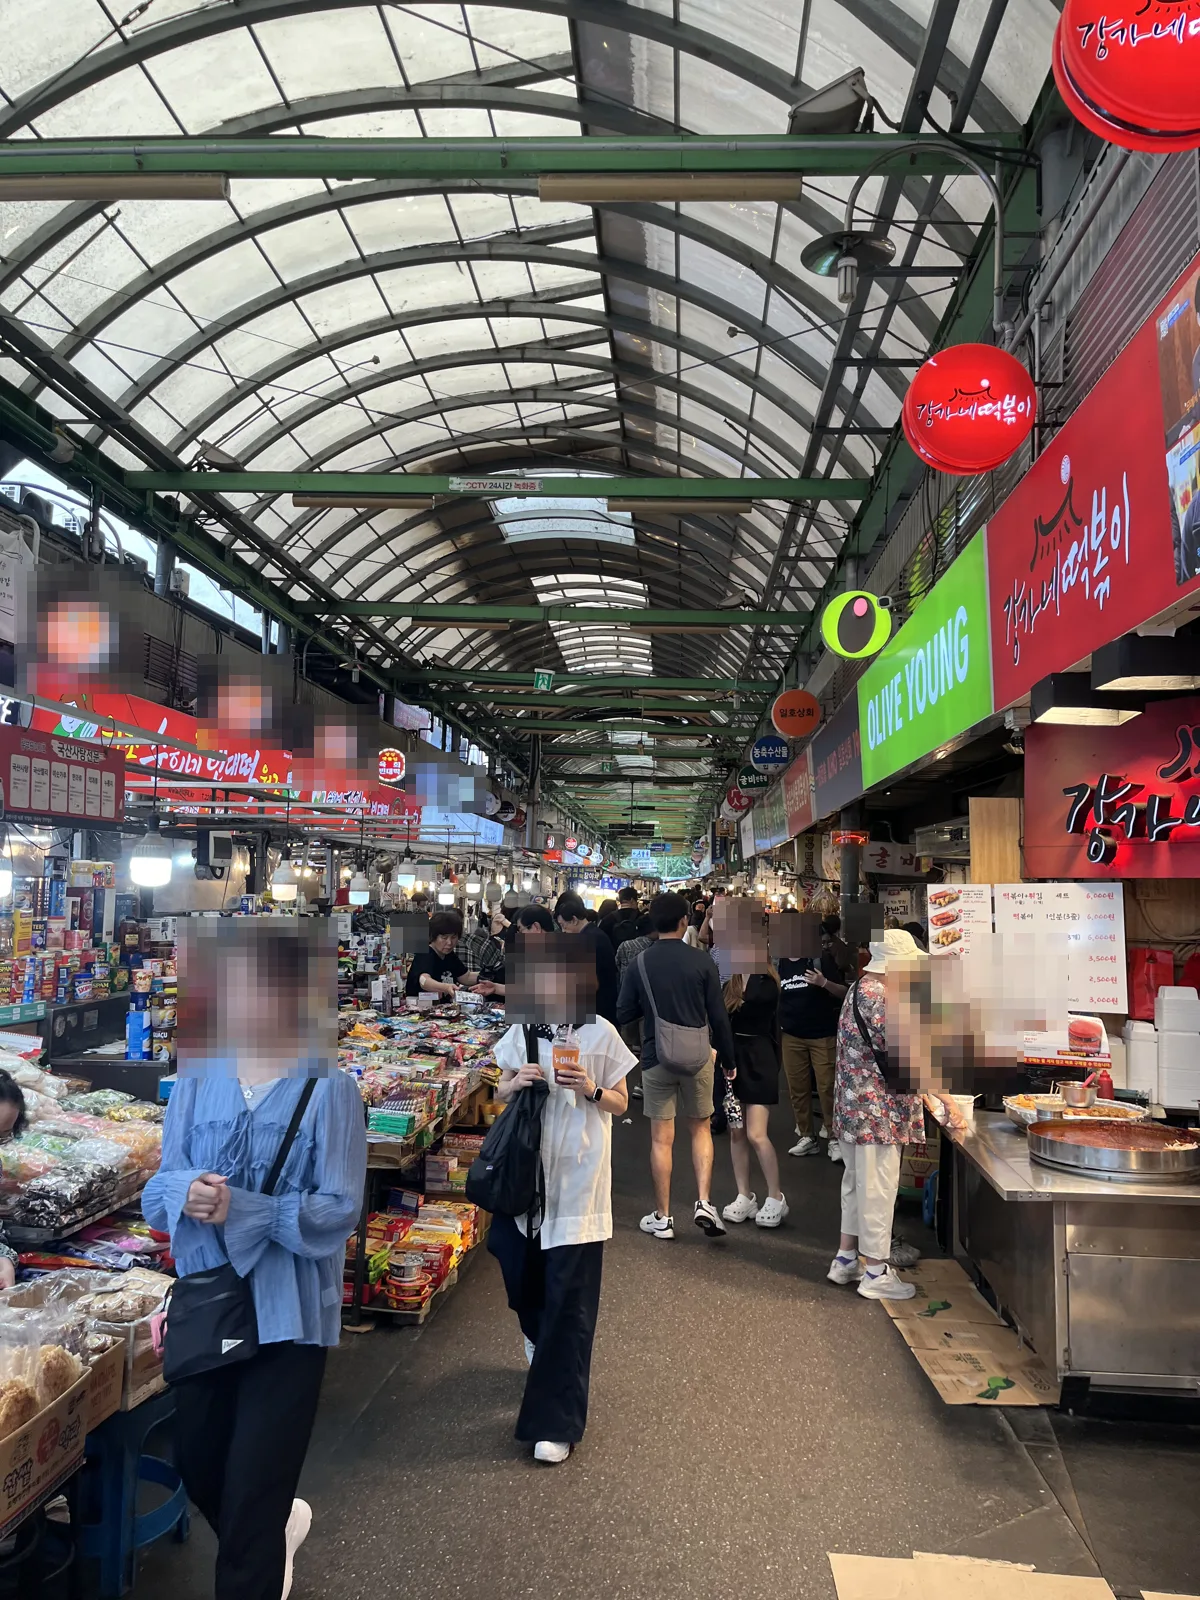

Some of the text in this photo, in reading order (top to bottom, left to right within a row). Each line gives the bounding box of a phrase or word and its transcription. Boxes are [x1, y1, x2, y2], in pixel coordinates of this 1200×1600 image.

[1077, 13, 1200, 60] 강가네
[917, 394, 1031, 427] 강가네떡볶이
[488, 482, 512, 490] 24시간
[514, 482, 536, 490] 녹화중
[1003, 471, 1130, 666] 강가네떡볶이
[867, 605, 969, 751] OLIVE YOUNG
[779, 707, 814, 718] 일호상회
[57, 741, 100, 764] 국산사탕전문
[753, 746, 789, 758] 농축수산물
[1086, 892, 1115, 900] 6,000원
[1087, 913, 1115, 921] 6,000원
[1089, 955, 1117, 963] 3,500원
[1089, 976, 1118, 984] 2,500원
[1089, 996, 1118, 1005] 3,000원
